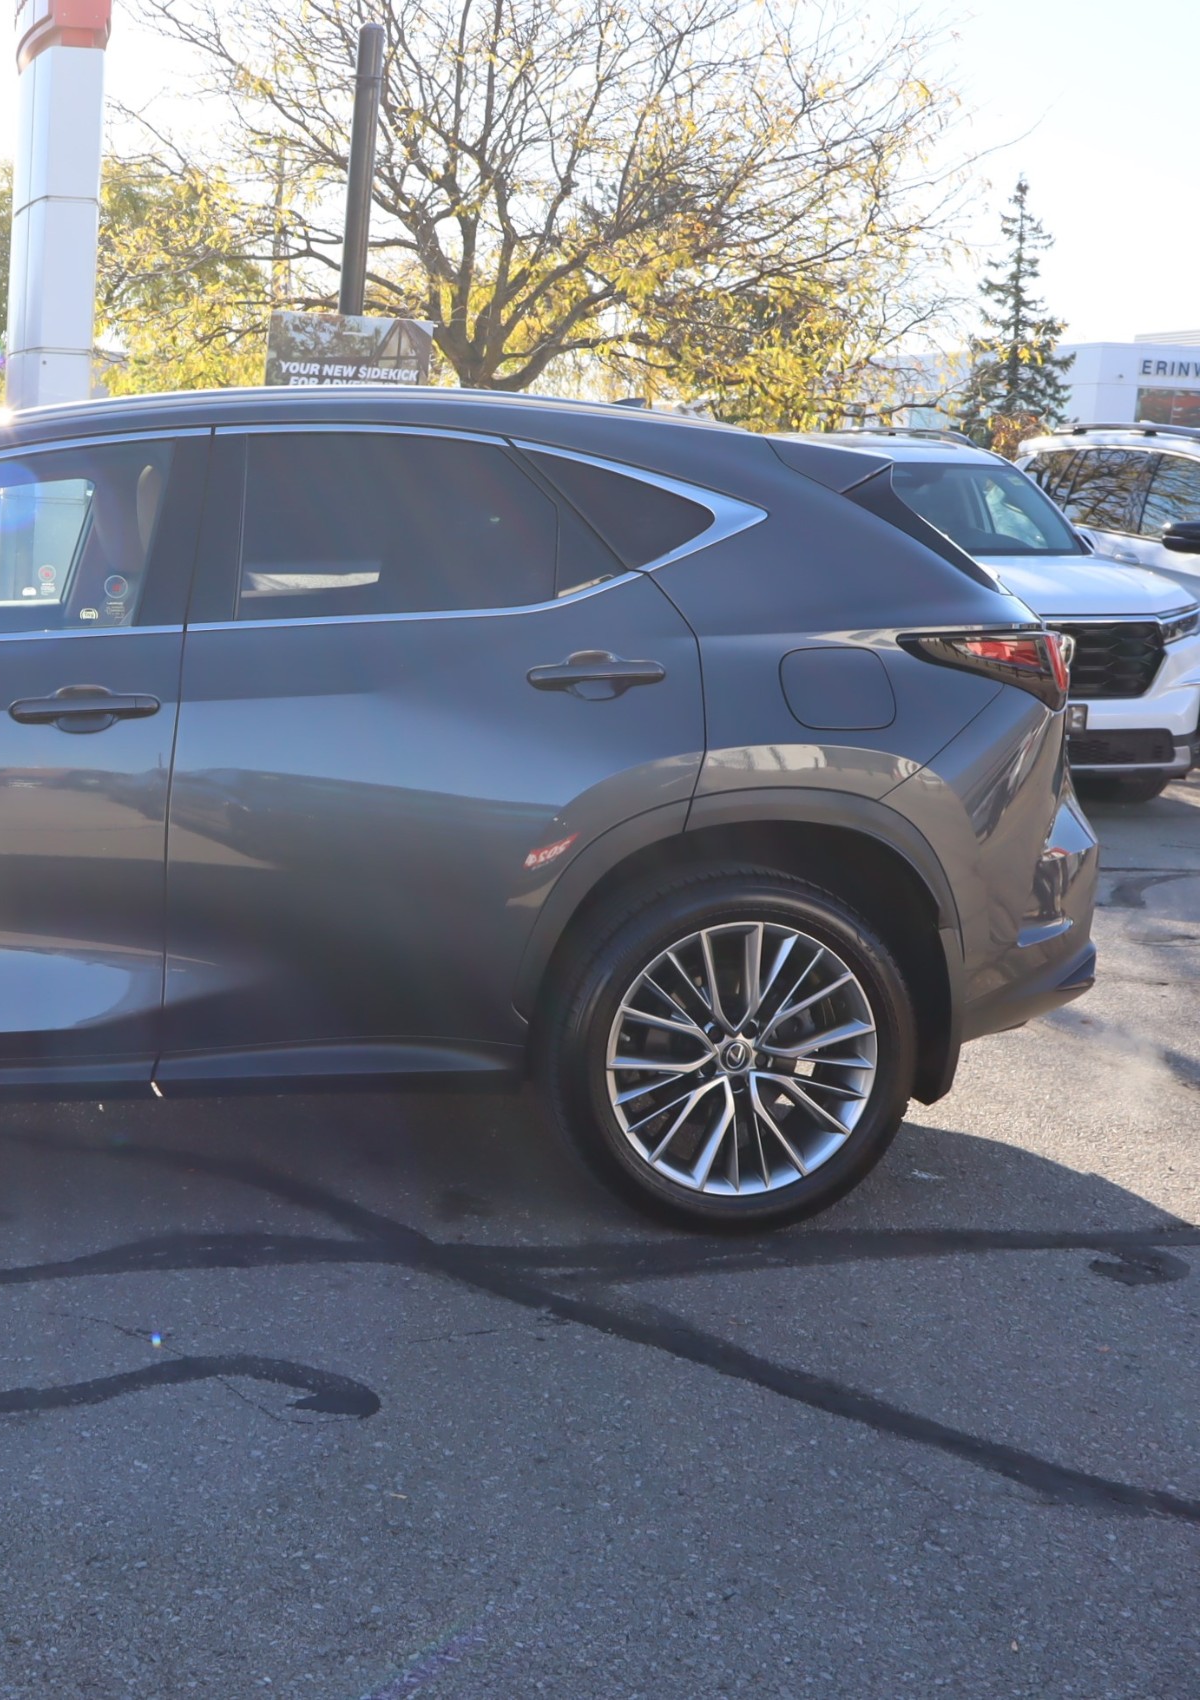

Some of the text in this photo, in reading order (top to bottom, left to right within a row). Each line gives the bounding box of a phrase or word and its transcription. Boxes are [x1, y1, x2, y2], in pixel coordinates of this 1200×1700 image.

[280, 361, 419, 381] YOUR NEW SIDEKICK
